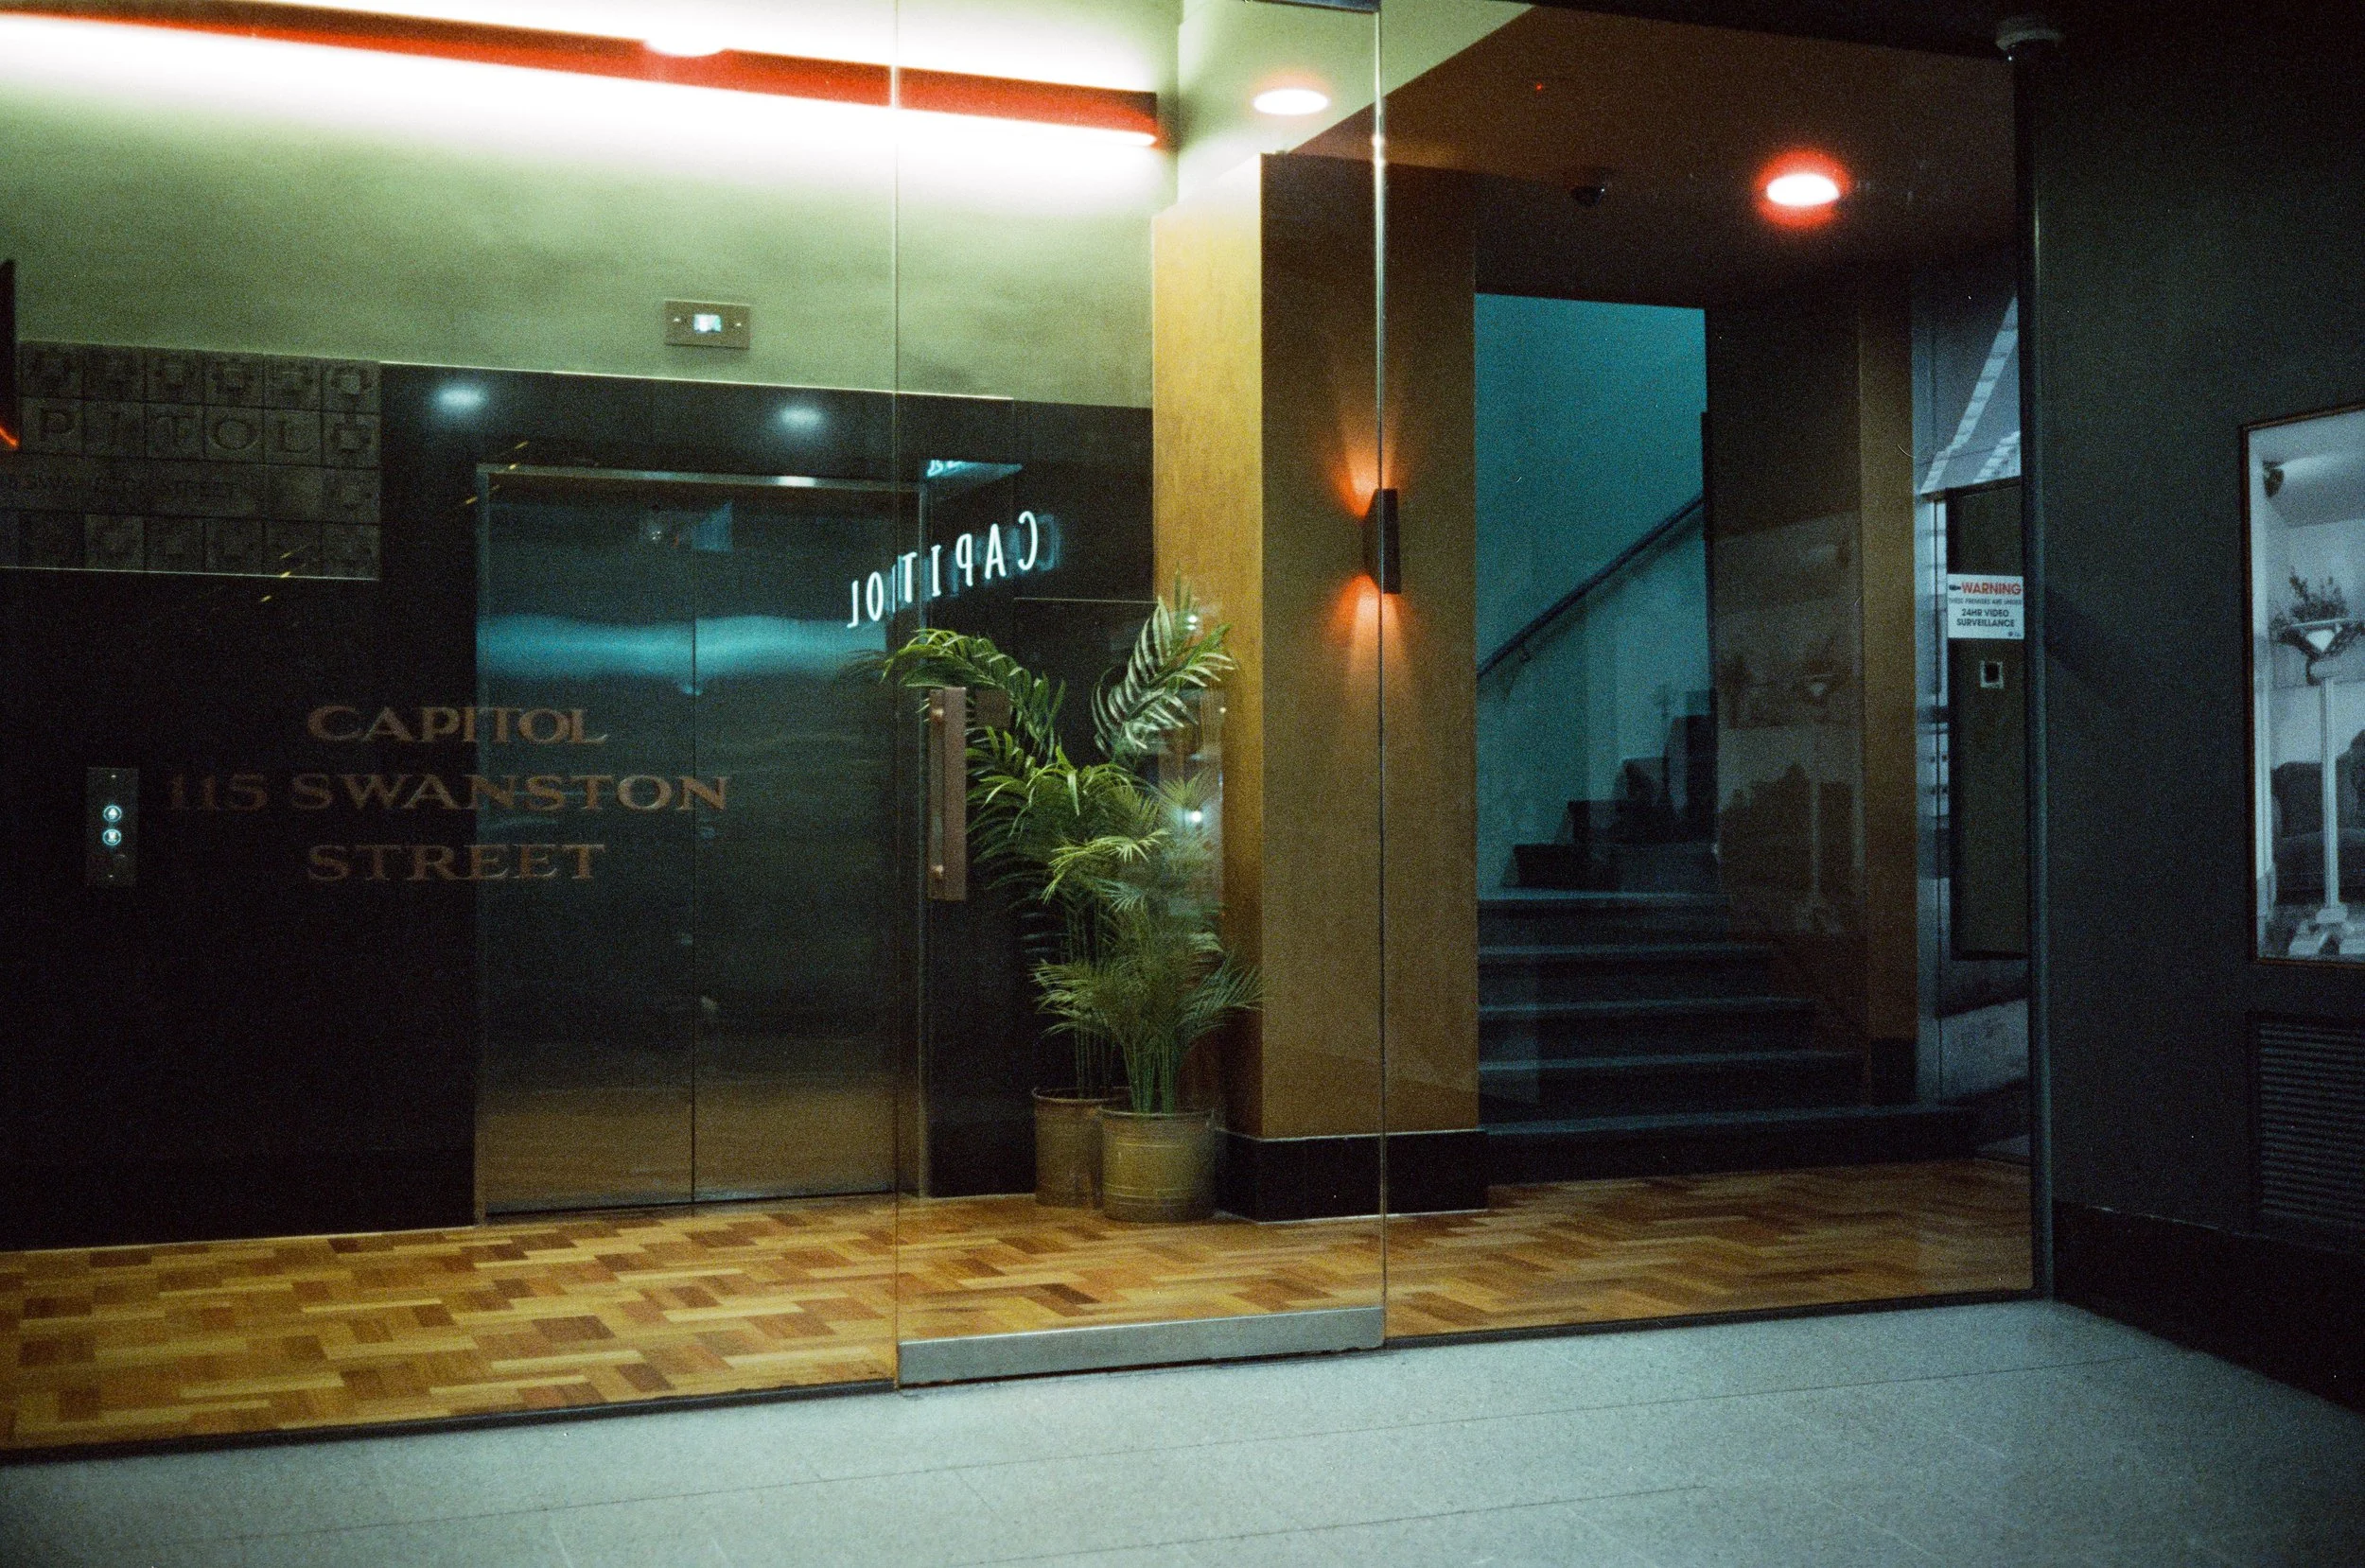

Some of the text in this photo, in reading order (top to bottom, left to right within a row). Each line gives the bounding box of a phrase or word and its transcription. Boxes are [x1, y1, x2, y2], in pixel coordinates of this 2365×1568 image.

[1962, 582, 2022, 595] WARNING
[1956, 618, 2015, 627] SURVEILLANCE
[1961, 608, 2009, 618] 24HR VIDEO
[307, 706, 609, 745] CAPITOL
[168, 774, 729, 812] 115 SWANSTON
[307, 843, 606, 882] STREET
